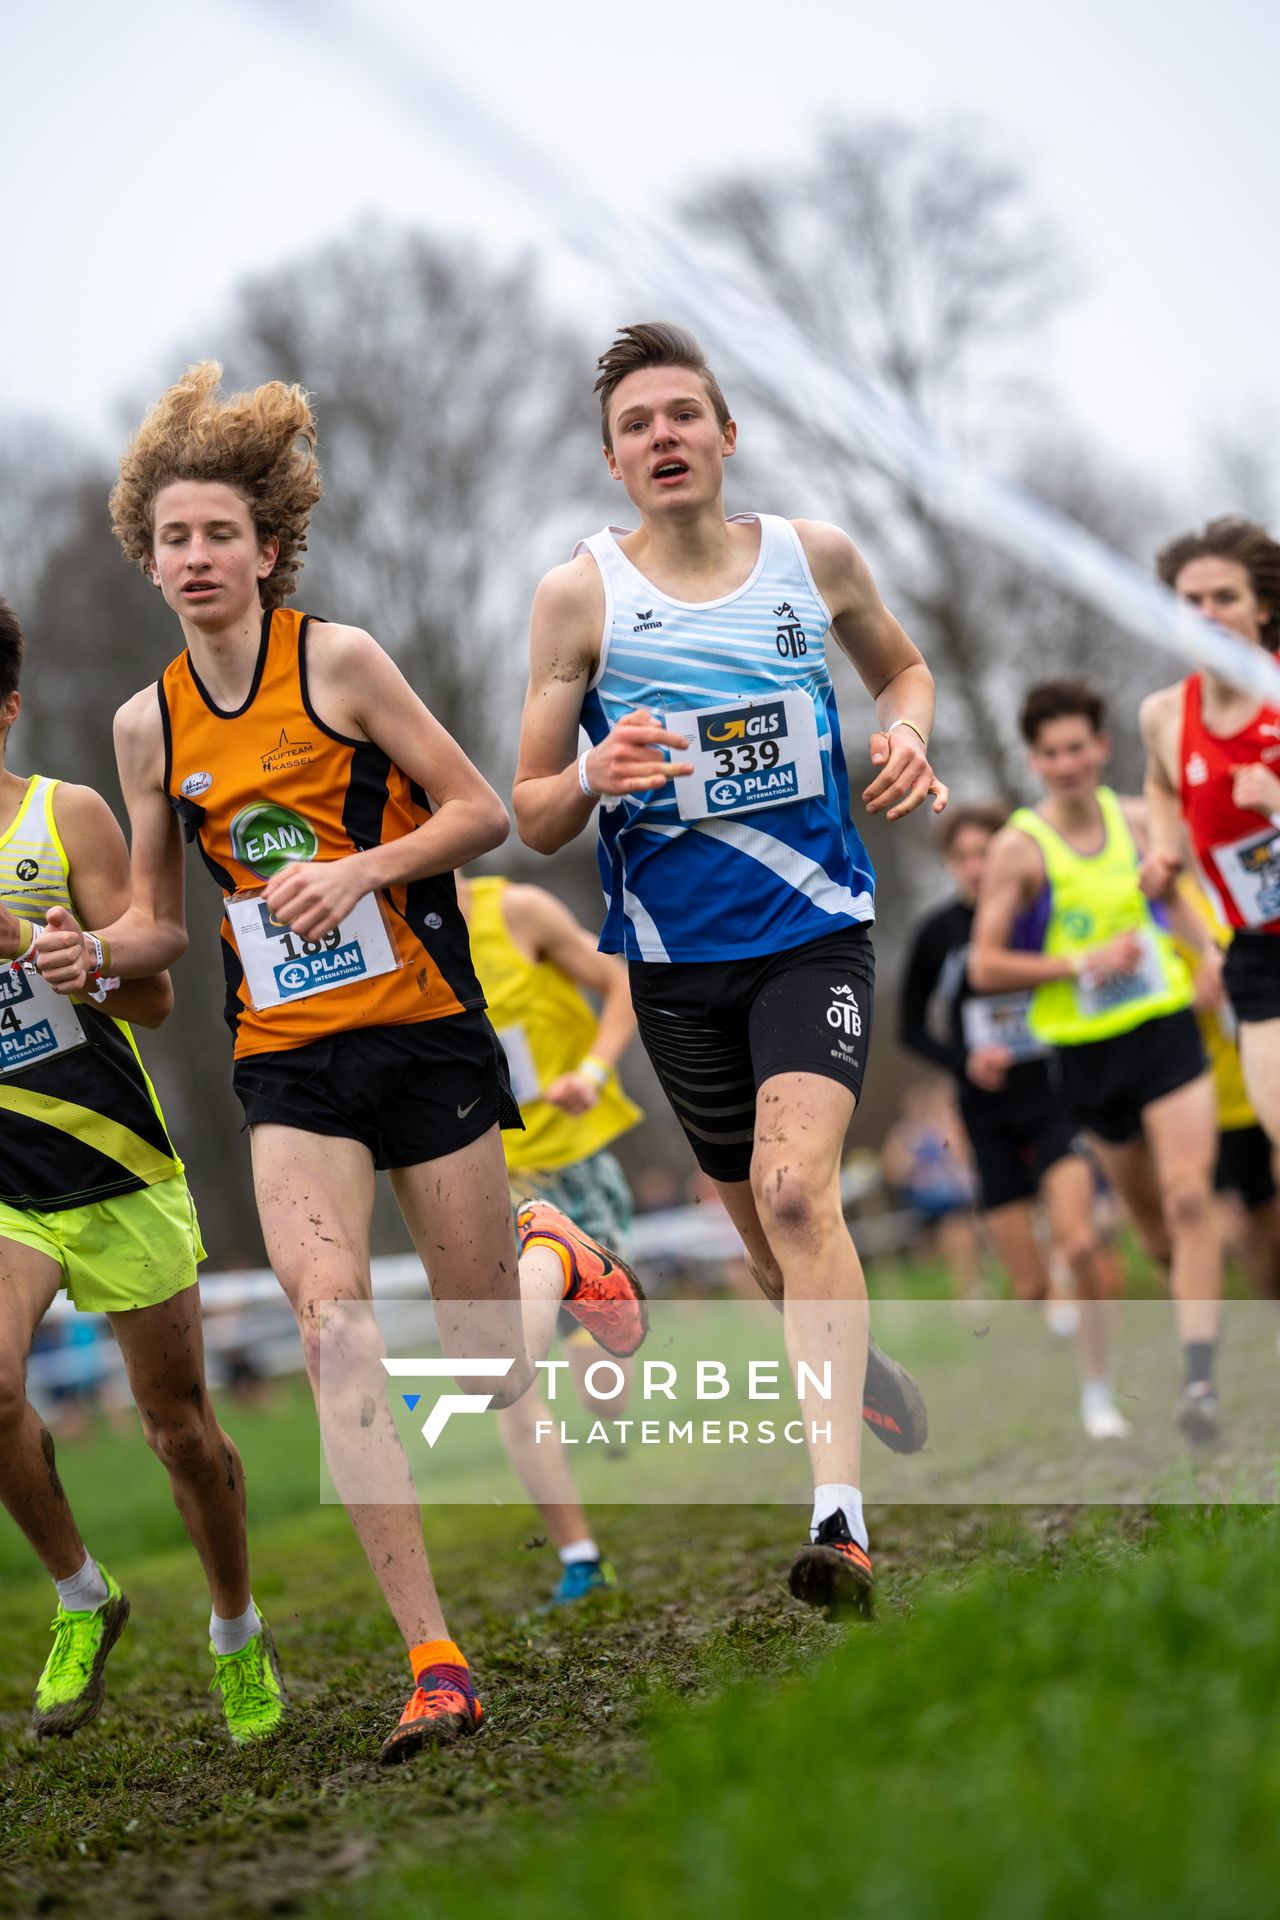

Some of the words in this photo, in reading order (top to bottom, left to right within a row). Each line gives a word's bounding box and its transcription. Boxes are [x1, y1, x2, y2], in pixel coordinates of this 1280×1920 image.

[633, 621, 663, 632] erima
[776, 623, 807, 658] OTB
[746, 712, 780, 736] GLS
[272, 757, 316, 772] KASSEL
[713, 740, 780, 777] 339
[744, 769, 794, 793] PLAN
[746, 786, 795, 800] INTERNATIONAL
[246, 825, 305, 862] EAM
[310, 948, 360, 975] PLAN
[314, 965, 362, 983] INTERNATIONAL
[0, 1007, 22, 1037] 4
[826, 1000, 862, 1037] OTB
[1, 1027, 51, 1055] PLAN
[7, 1042, 54, 1061] INTERNATIONAL
[830, 1049, 859, 1068] erima
